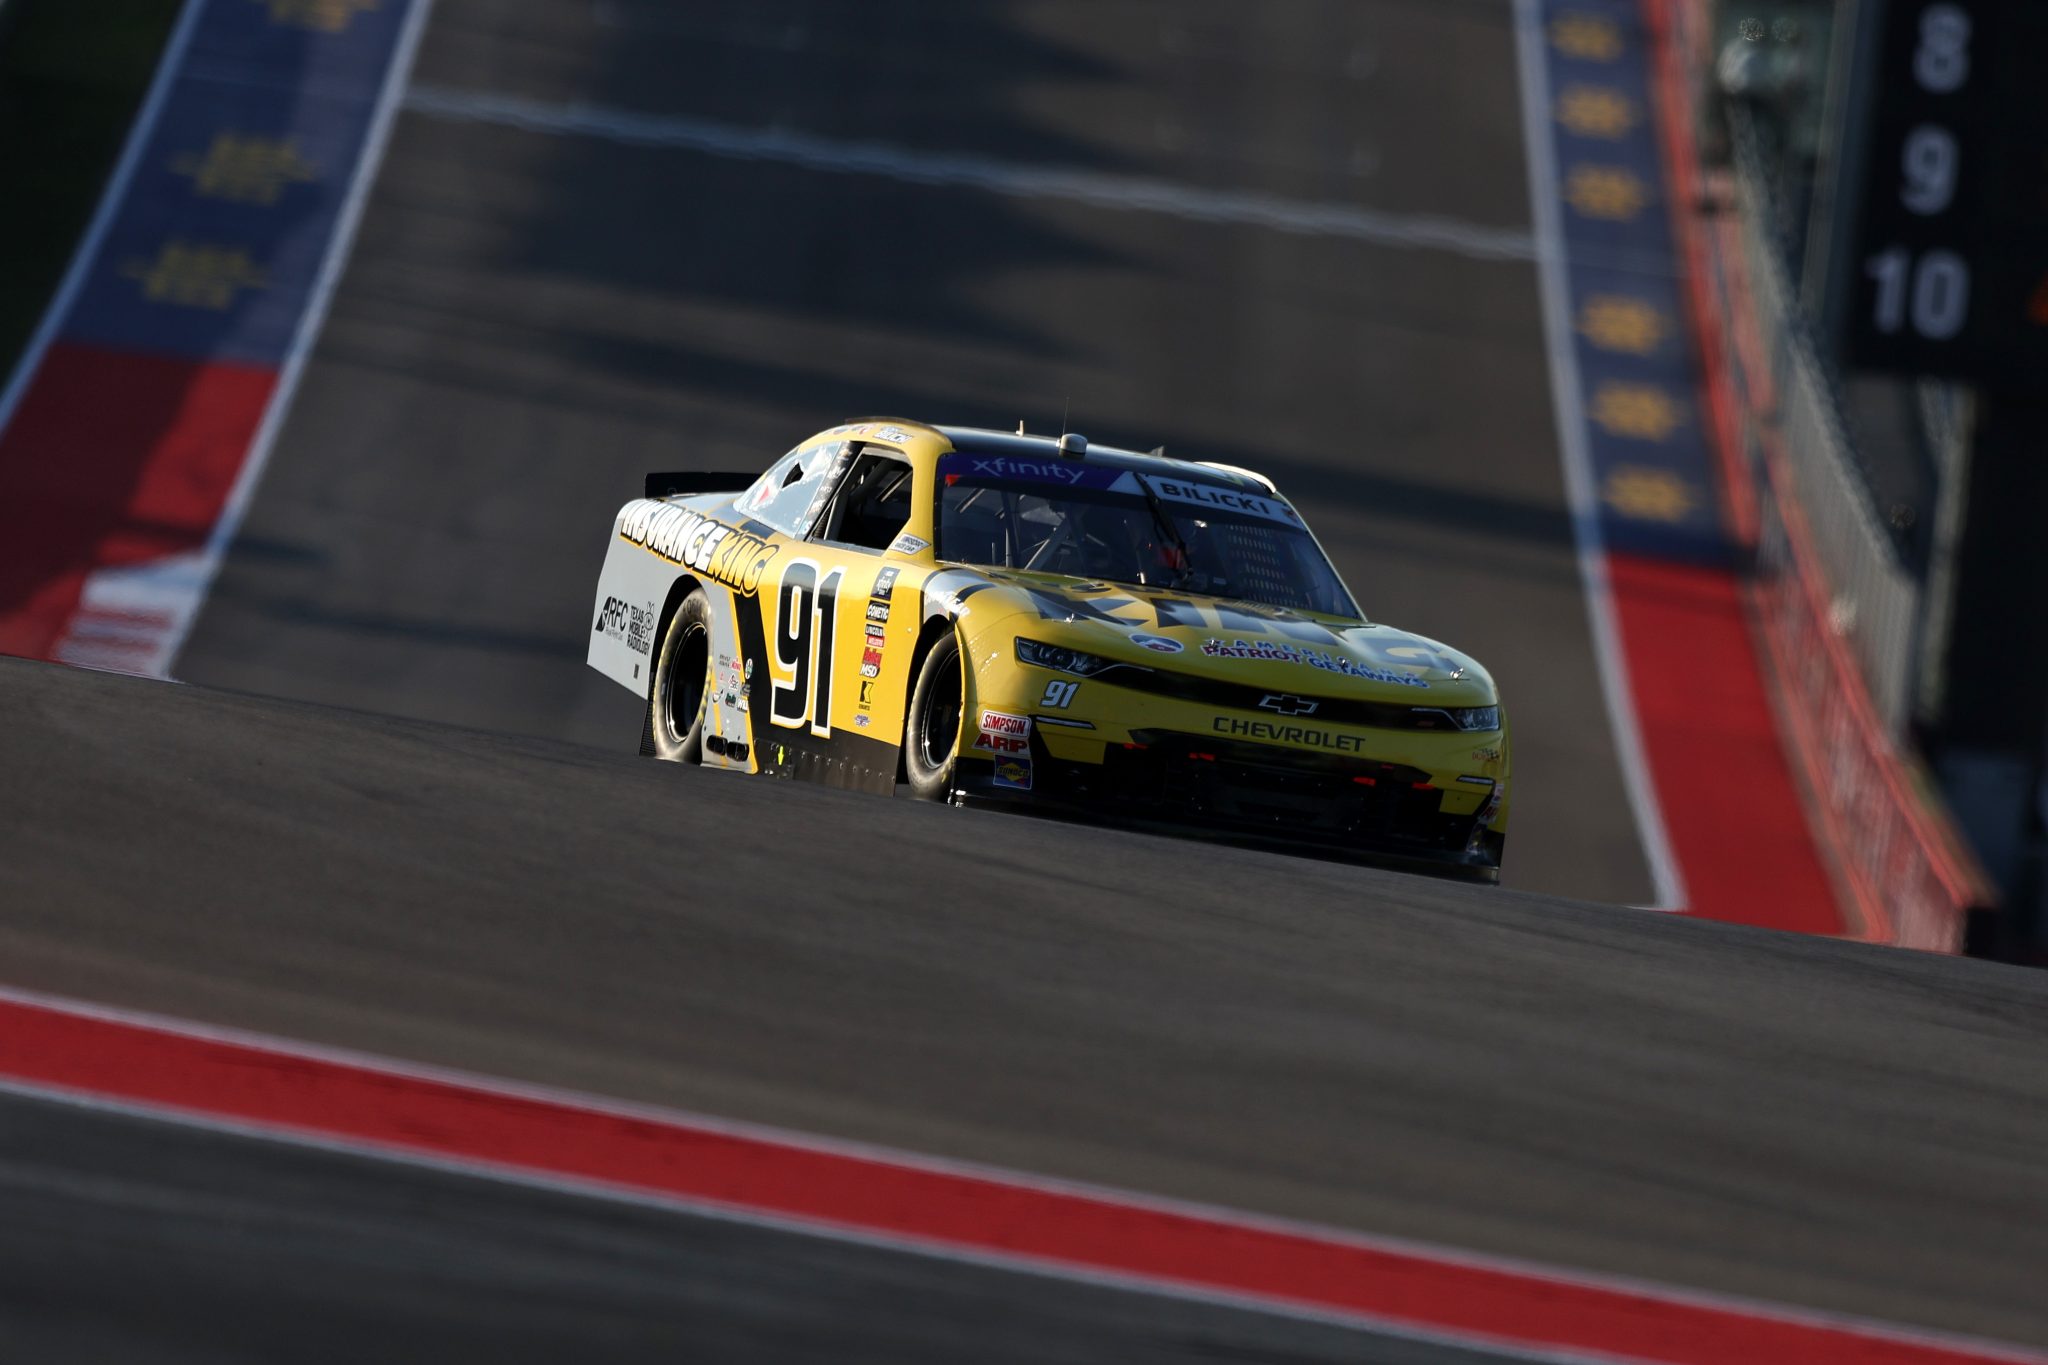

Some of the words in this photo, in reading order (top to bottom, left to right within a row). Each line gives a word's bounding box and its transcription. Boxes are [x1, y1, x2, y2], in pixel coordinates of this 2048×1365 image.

[1913, 4, 1971, 93] 8
[1901, 124, 1958, 216] 9
[1867, 245, 1969, 341] 10
[972, 457, 1085, 484] xfinity
[1159, 480, 1271, 516] BILICKI
[607, 596, 629, 632] RFC
[631, 605, 645, 624] TEXAS
[770, 557, 848, 739] 91
[1201, 645, 1302, 664] PATRIOT
[860, 663, 879, 678] MSD
[1039, 679, 1080, 709] 91
[983, 714, 1026, 735] SIMPSON
[1212, 716, 1366, 752] CHEVROLET
[974, 732, 1028, 753] ARP
